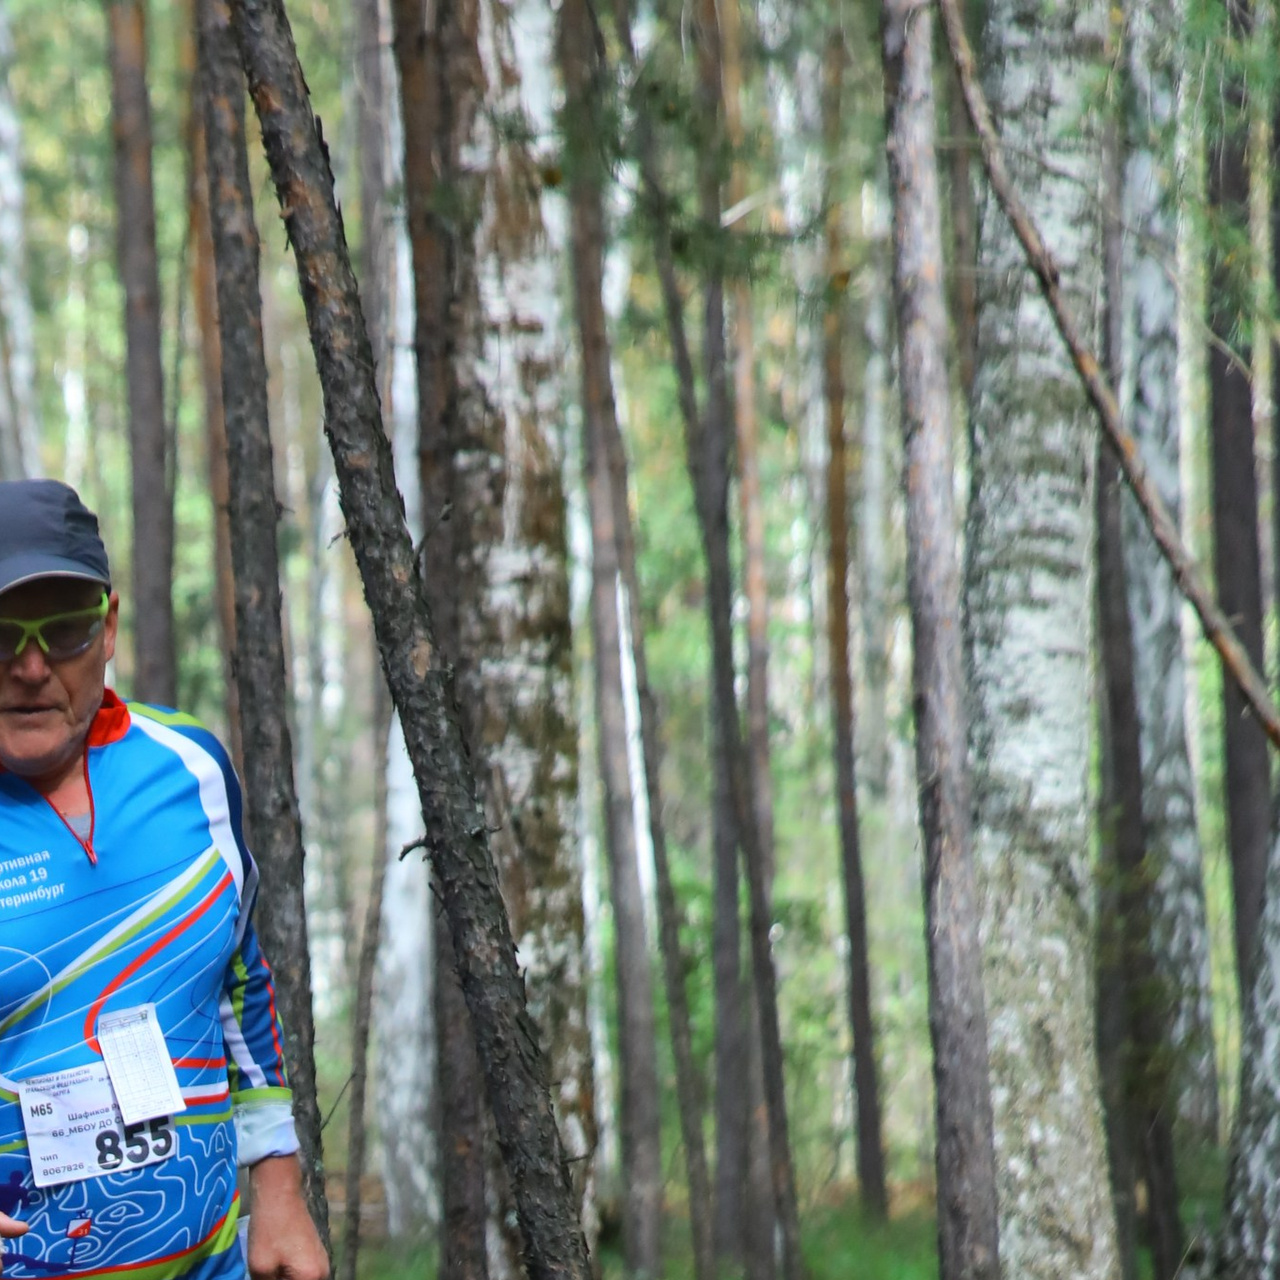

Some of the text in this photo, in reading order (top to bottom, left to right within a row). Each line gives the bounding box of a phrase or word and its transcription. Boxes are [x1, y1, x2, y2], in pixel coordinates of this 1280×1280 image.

[29, 867, 48, 882] 19
[67, 1107, 110, 1121] Шафиков
[52, 1122, 96, 1138] 66_МБОУ
[99, 1119, 113, 1129] ДО
[95, 1115, 173, 1170] 855
[40, 1154, 59, 1162] чип
[43, 1163, 85, 1176] 8067826
